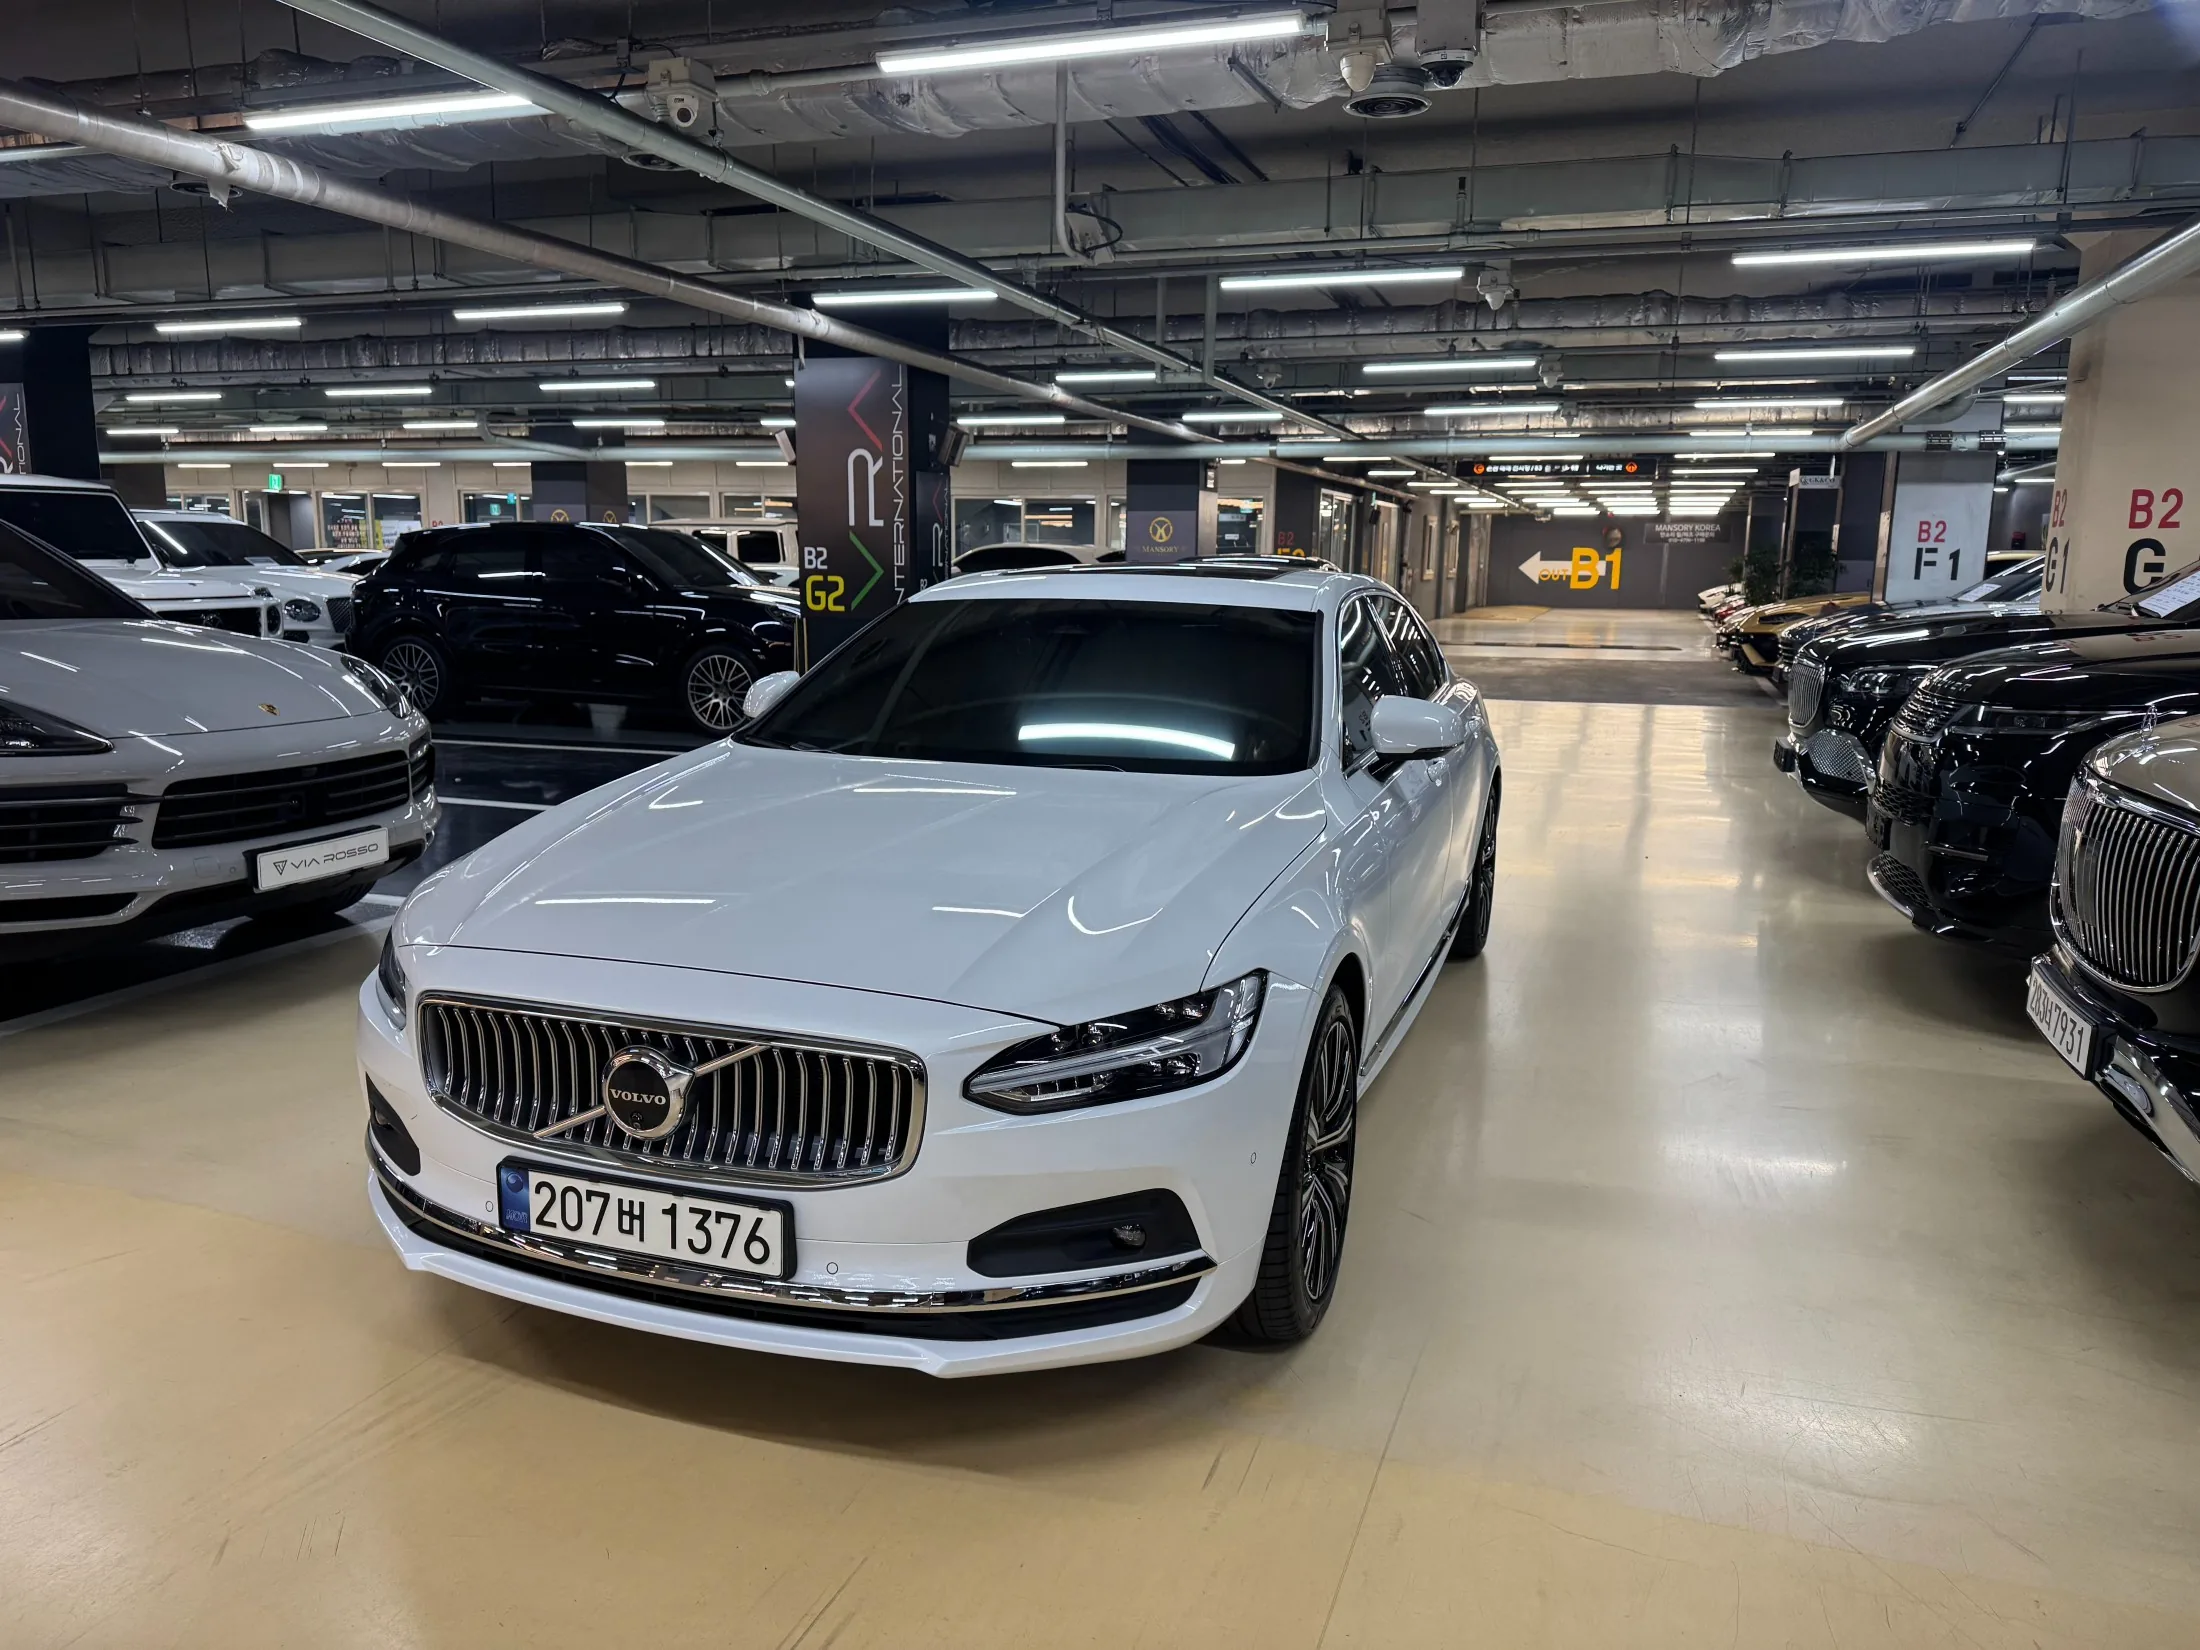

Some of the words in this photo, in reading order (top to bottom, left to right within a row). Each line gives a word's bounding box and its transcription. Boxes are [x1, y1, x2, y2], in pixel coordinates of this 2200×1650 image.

[892, 363, 906, 606] NTERNATIONAL
[2051, 488, 2068, 528] B2
[2128, 488, 2184, 529] B2
[1655, 523, 1694, 532] MANSORY
[1695, 523, 1721, 532] KOREA
[1917, 520, 1947, 543] B2
[804, 546, 828, 570] B2
[1142, 545, 1179, 553] MANSORY
[1913, 547, 1961, 581] F1
[2044, 537, 2071, 595] G1
[1539, 568, 1569, 582] OUT
[1569, 547, 1623, 590] B1
[805, 575, 845, 612] G2
[290, 856, 320, 870] VIA
[323, 843, 379, 864] ROSSO
[2053, 1003, 2084, 1063] 7931
[609, 1087, 667, 1105] VOLVO
[533, 1180, 646, 1243] 207버
[661, 1202, 771, 1265] 1376
